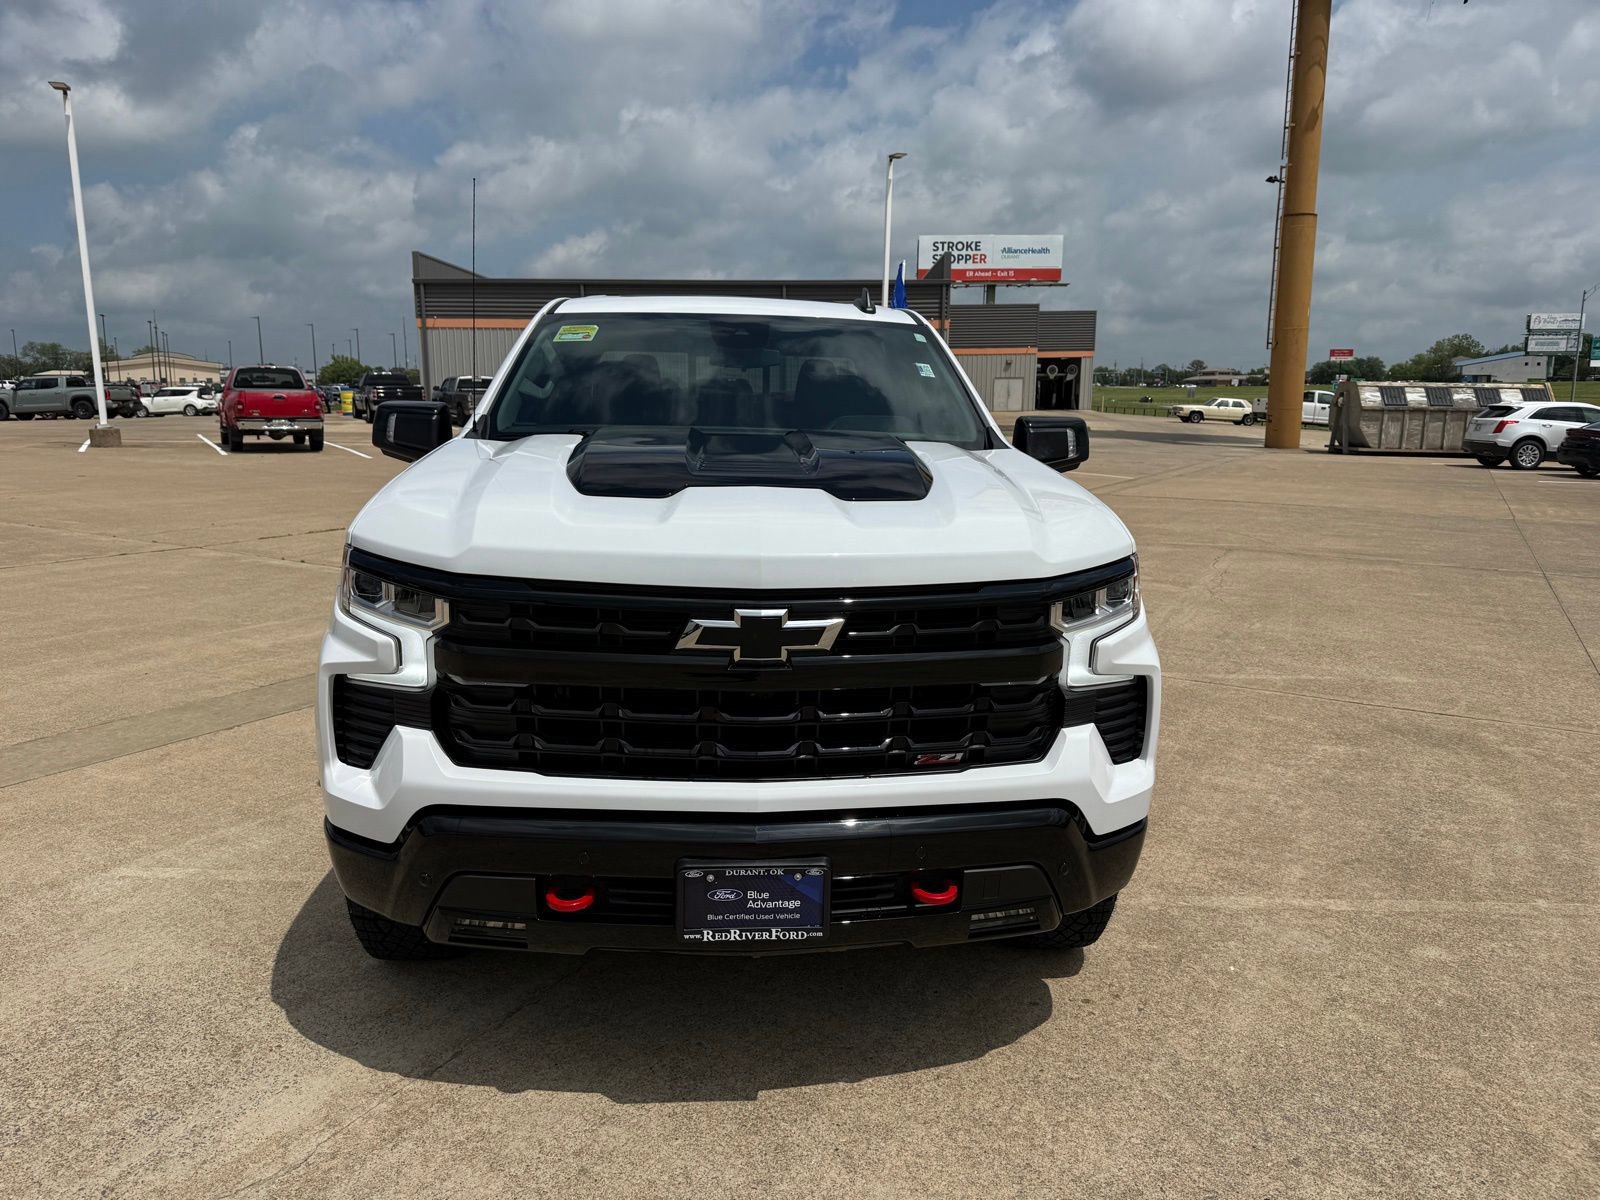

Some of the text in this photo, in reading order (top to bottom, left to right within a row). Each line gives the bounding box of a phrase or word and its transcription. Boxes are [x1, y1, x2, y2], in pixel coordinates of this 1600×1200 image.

[932, 241, 982, 252] STROKE
[1001, 247, 1050, 255] AllianceHealth
[932, 254, 987, 264] SOPPER
[771, 868, 784, 876] OK
[747, 890, 770, 899] Blue
[747, 899, 801, 909] Advantage
[724, 913, 755, 921] Certified
[775, 912, 801, 920] Vehicle
